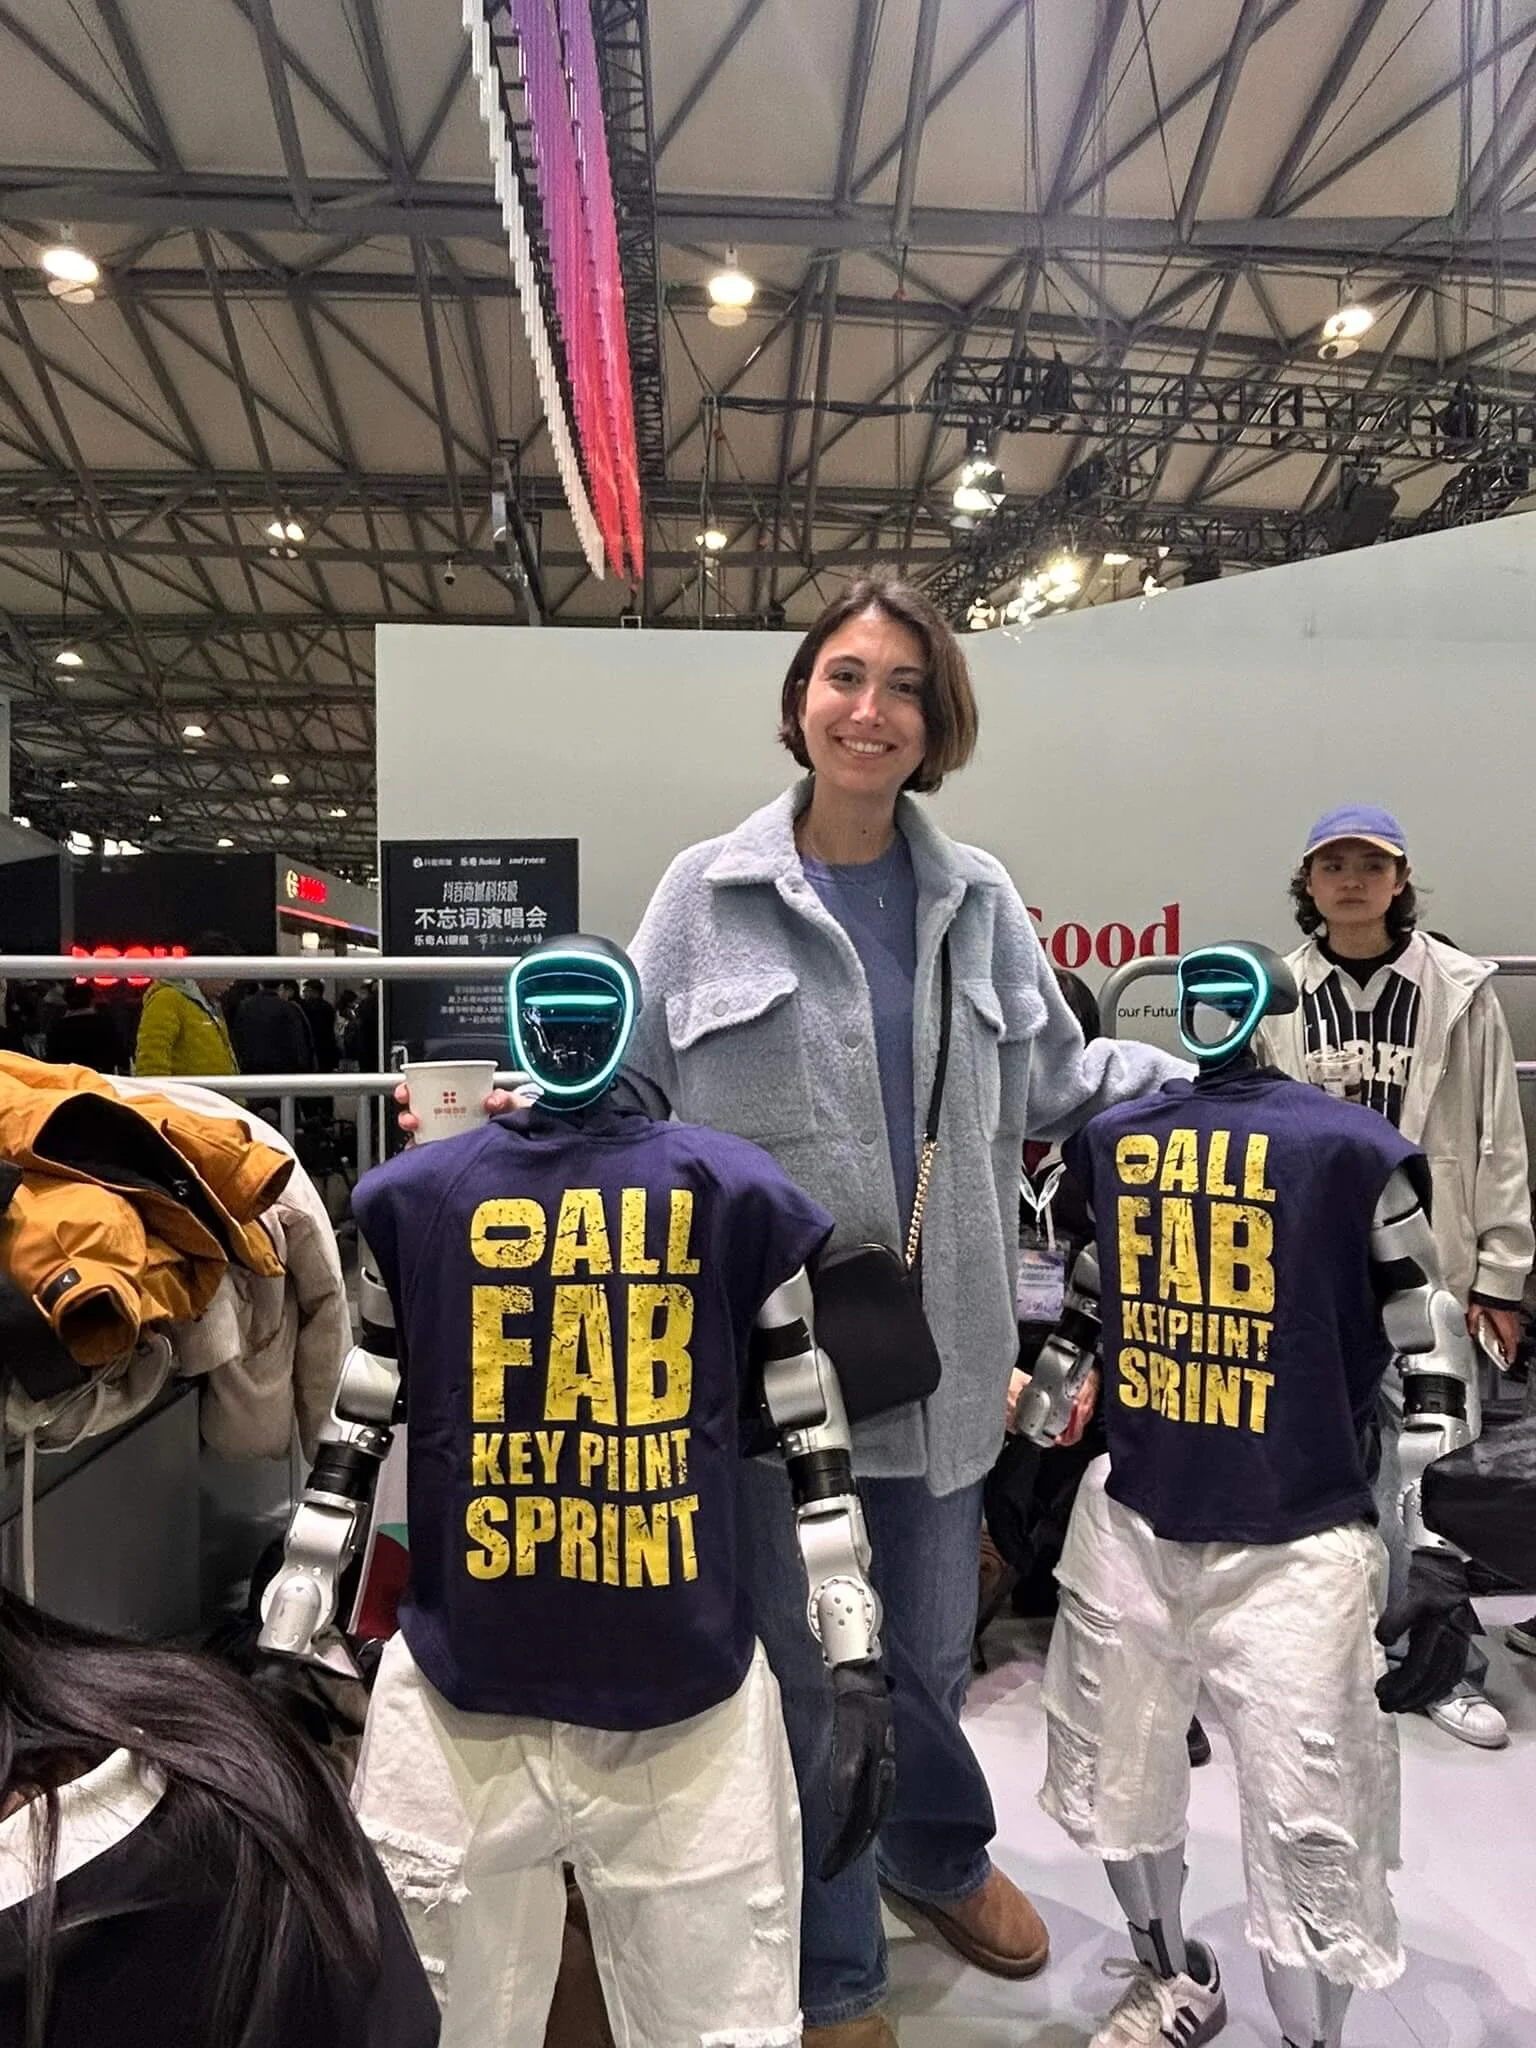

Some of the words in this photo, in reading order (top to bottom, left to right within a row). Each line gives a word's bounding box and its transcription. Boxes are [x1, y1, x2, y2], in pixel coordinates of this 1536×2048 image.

[415, 905, 548, 930] 不忘词演唱会
[1143, 1005, 1179, 1018] Futur
[1117, 1195, 1276, 1315] FAB
[471, 1283, 696, 1427] FAB
[1118, 1347, 1276, 1434] SPRINT
[472, 1430, 566, 1488] KEY
[465, 1494, 700, 1589] SPRINT
